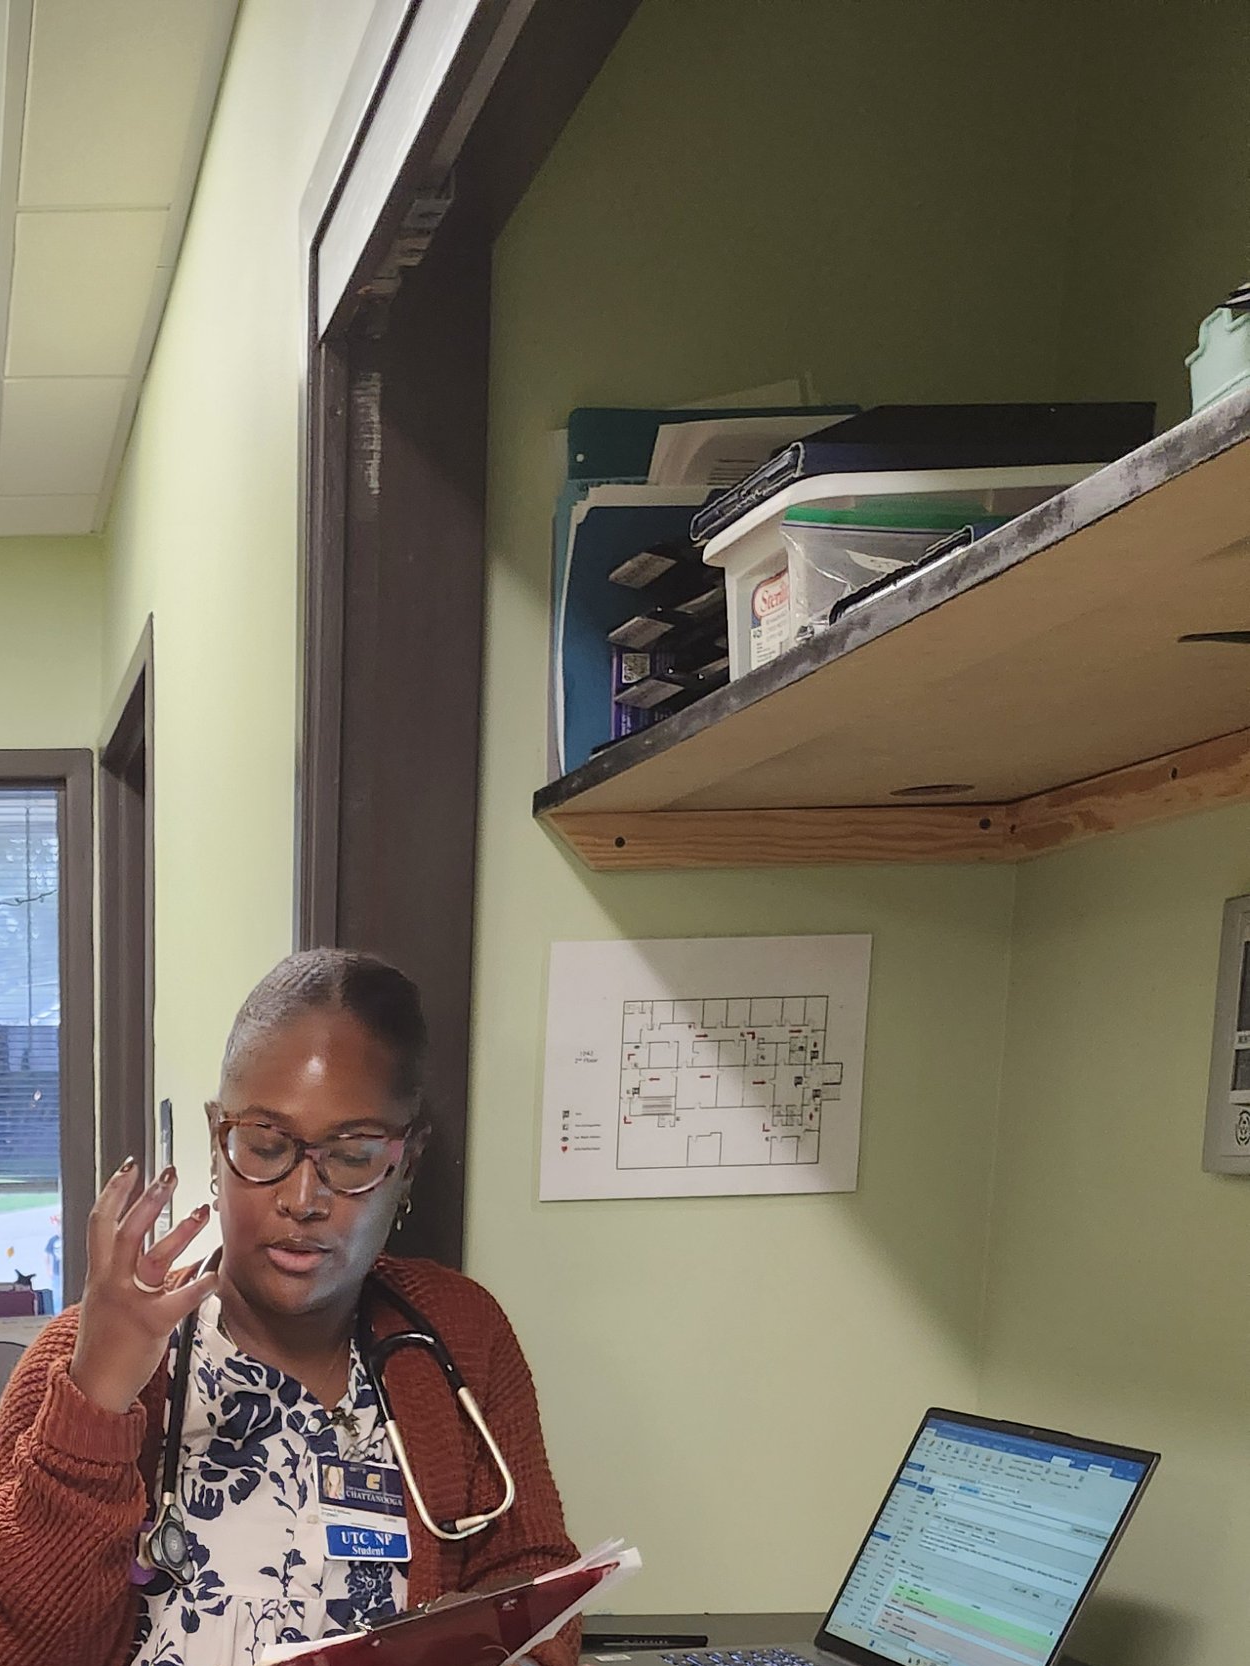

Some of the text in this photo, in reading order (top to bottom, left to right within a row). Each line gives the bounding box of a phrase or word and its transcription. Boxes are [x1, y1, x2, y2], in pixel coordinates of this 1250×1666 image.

[345, 1490, 403, 1506] CHATTANOOGA
[341, 1531, 392, 1546] UTC NP
[352, 1546, 384, 1556] Student
